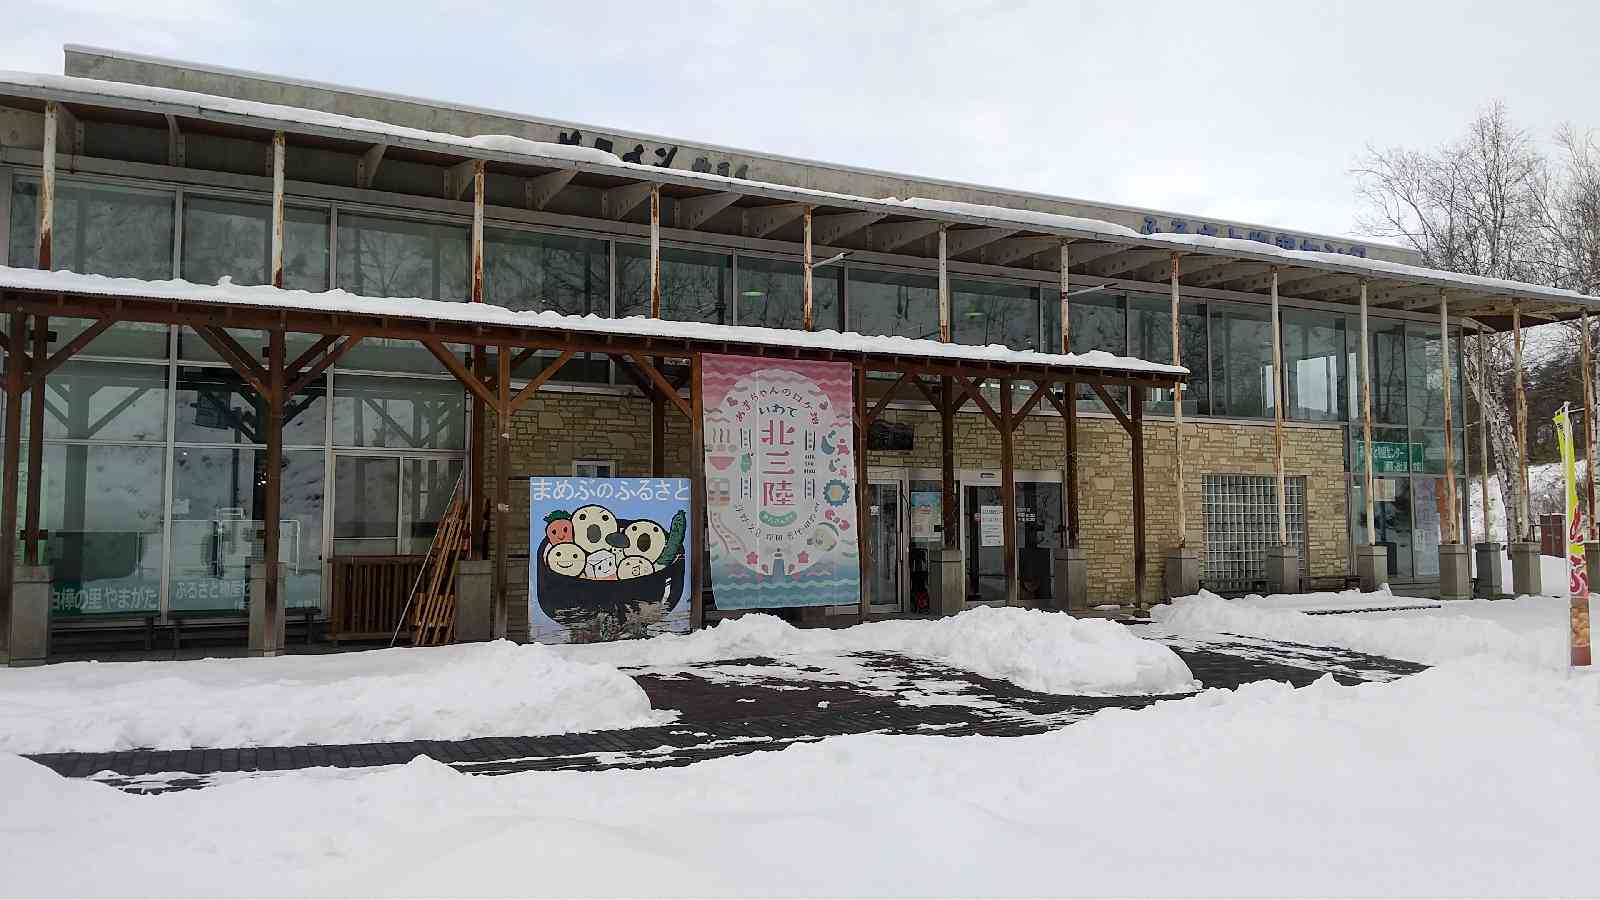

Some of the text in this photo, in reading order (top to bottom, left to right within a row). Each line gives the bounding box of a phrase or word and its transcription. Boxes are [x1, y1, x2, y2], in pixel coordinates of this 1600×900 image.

[758, 404, 800, 418] いわて
[758, 418, 798, 507] 北三陸
[531, 478, 691, 502] まめぶのふるさと
